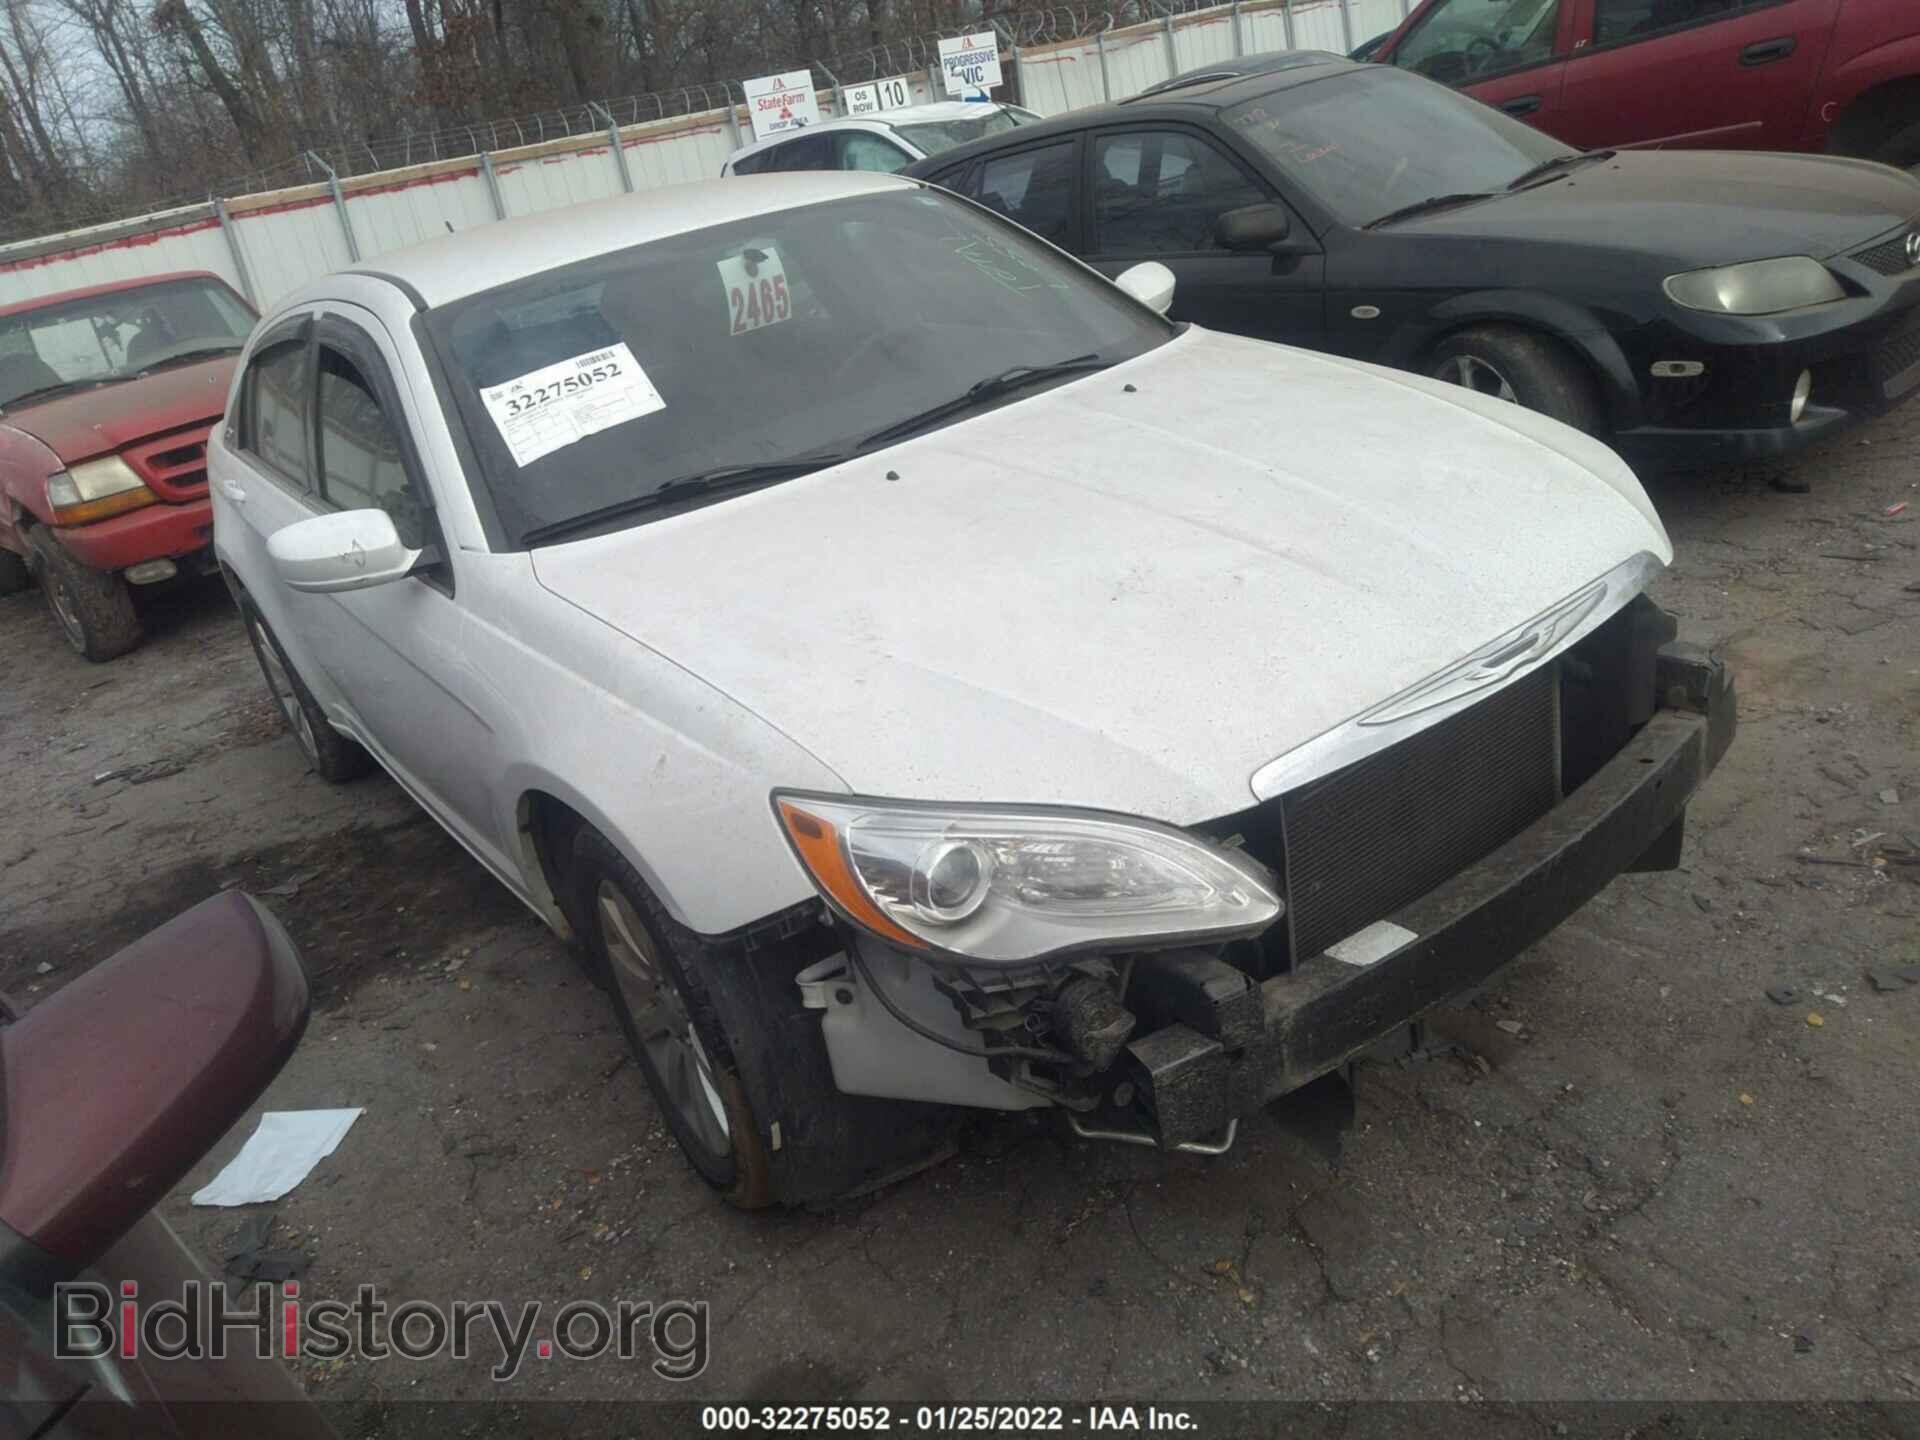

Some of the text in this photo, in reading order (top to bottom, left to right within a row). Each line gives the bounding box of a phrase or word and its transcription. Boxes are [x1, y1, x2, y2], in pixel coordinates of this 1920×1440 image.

[943, 49, 996, 70] PROGRESSIVE
[961, 65, 984, 84] VIC
[854, 90, 868, 101] OS
[885, 81, 904, 107] 10
[852, 101, 873, 114] ROW
[731, 273, 789, 334] 2465
[504, 362, 623, 417] 32275052
